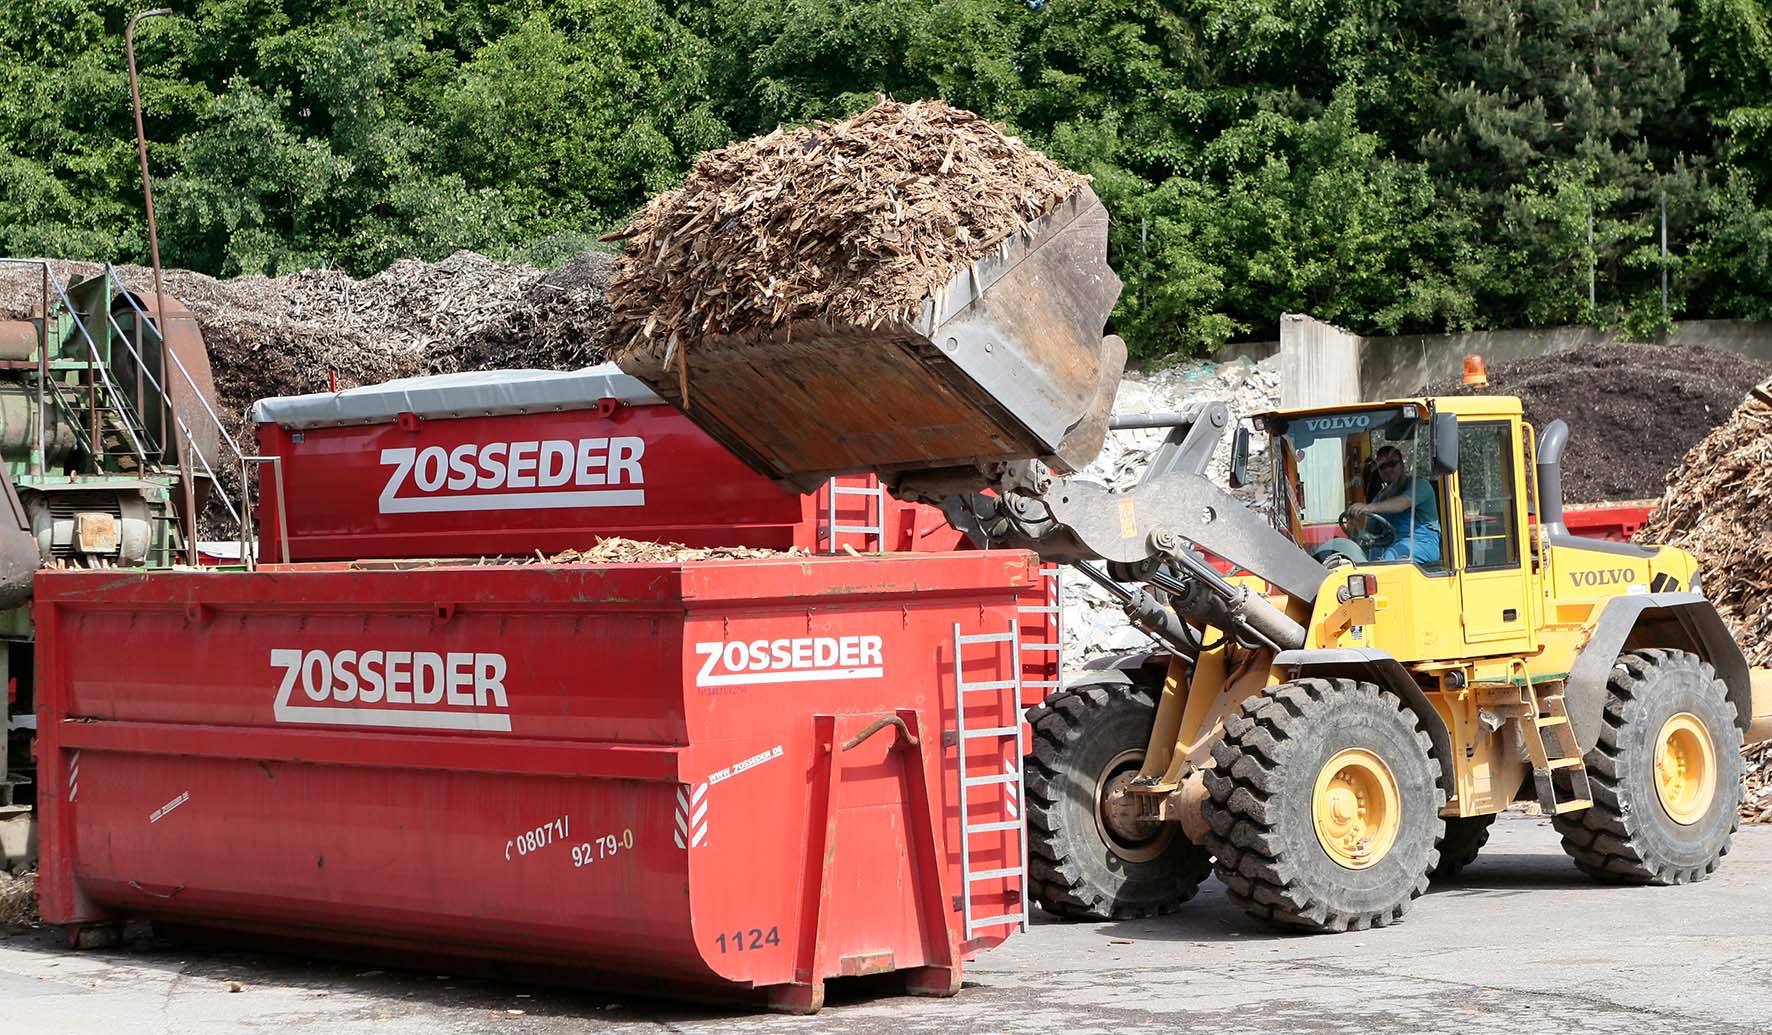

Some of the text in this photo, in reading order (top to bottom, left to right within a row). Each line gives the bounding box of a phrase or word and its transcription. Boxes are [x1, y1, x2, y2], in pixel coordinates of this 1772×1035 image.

[1305, 416, 1370, 431] VOLVO
[378, 436, 645, 514] ZOSSEDER
[1568, 568, 1635, 588] VOLVO
[695, 635, 883, 687] ZOSSEDER
[270, 649, 512, 732] ZOSSEDER
[571, 828, 633, 867] 92 79-0
[715, 926, 780, 954] 1124
